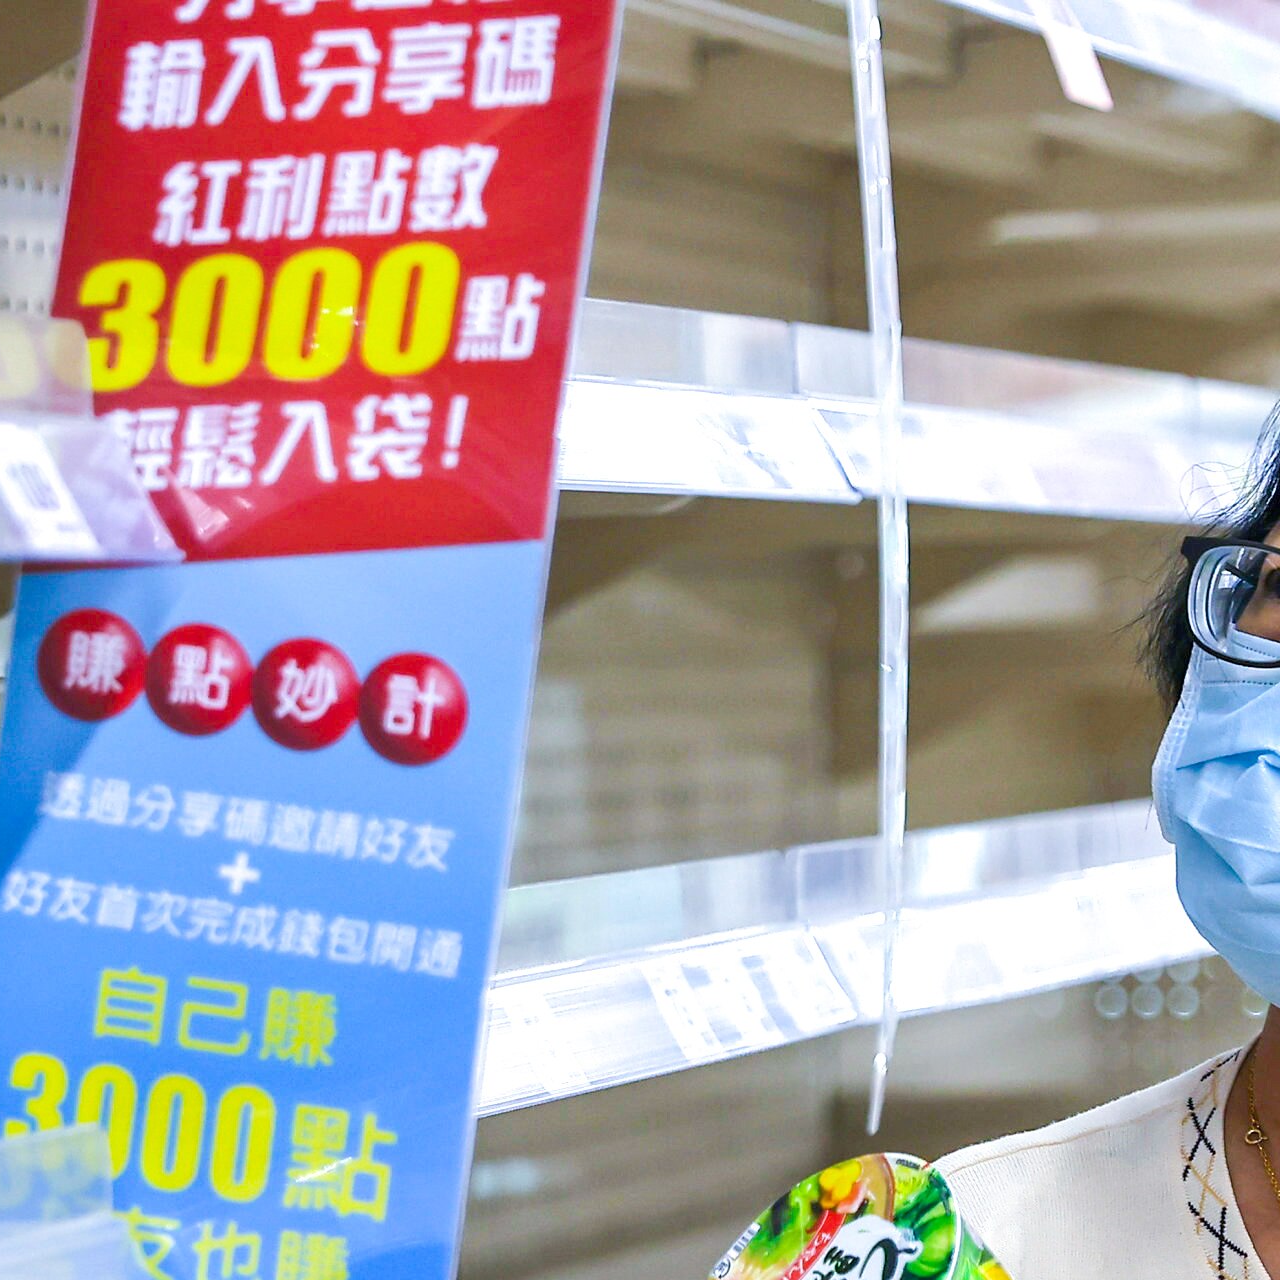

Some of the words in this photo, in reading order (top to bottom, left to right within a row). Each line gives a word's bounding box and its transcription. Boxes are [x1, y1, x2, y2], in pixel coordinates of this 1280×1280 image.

[118, 14, 561, 132] 輸入分享碼
[154, 144, 499, 246] 紅利點數
[79, 242, 544, 393] 3000點
[64, 630, 442, 742] 賺點妙計
[39, 771, 456, 872] 透過分享碼邀請好友
[1, 867, 464, 980] 好友首次完成錢包開通
[93, 966, 338, 1068] 自己賺
